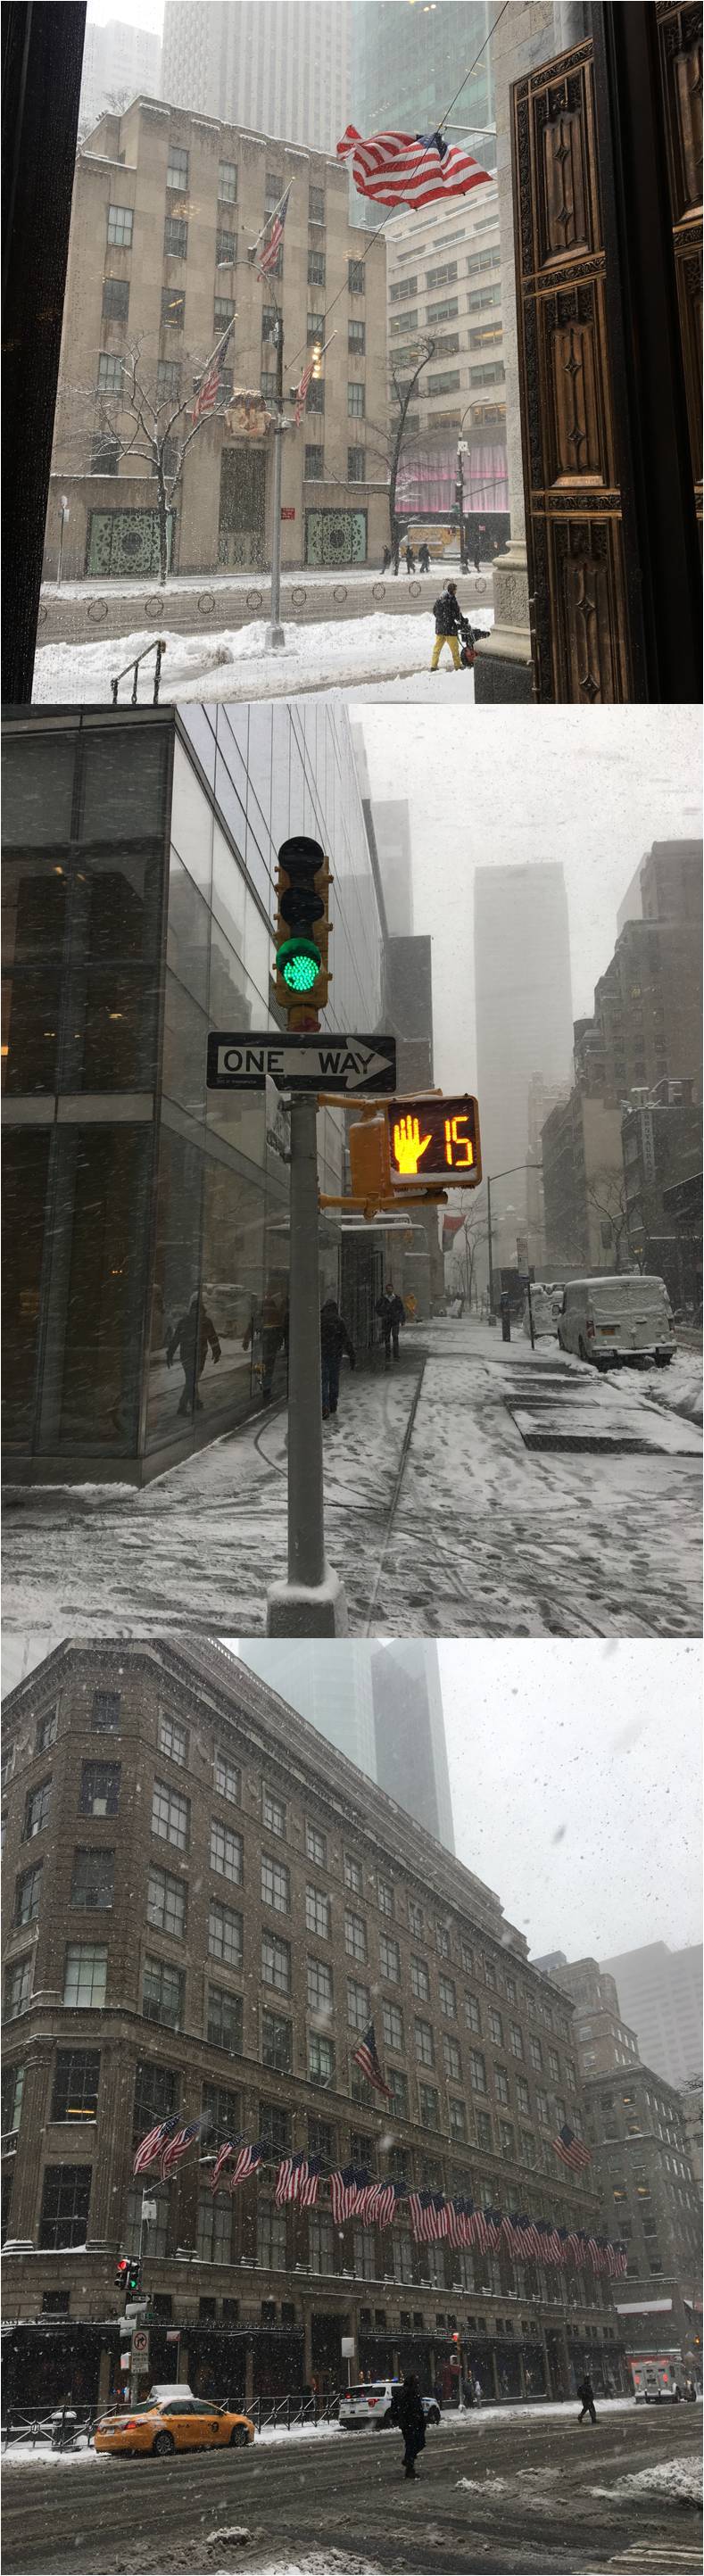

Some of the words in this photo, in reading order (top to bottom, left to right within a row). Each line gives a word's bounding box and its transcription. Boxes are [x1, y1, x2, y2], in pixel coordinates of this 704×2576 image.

[223, 1049, 285, 1073] ONE
[318, 1052, 376, 1074] WAY
[444, 1115, 474, 1166] 15
